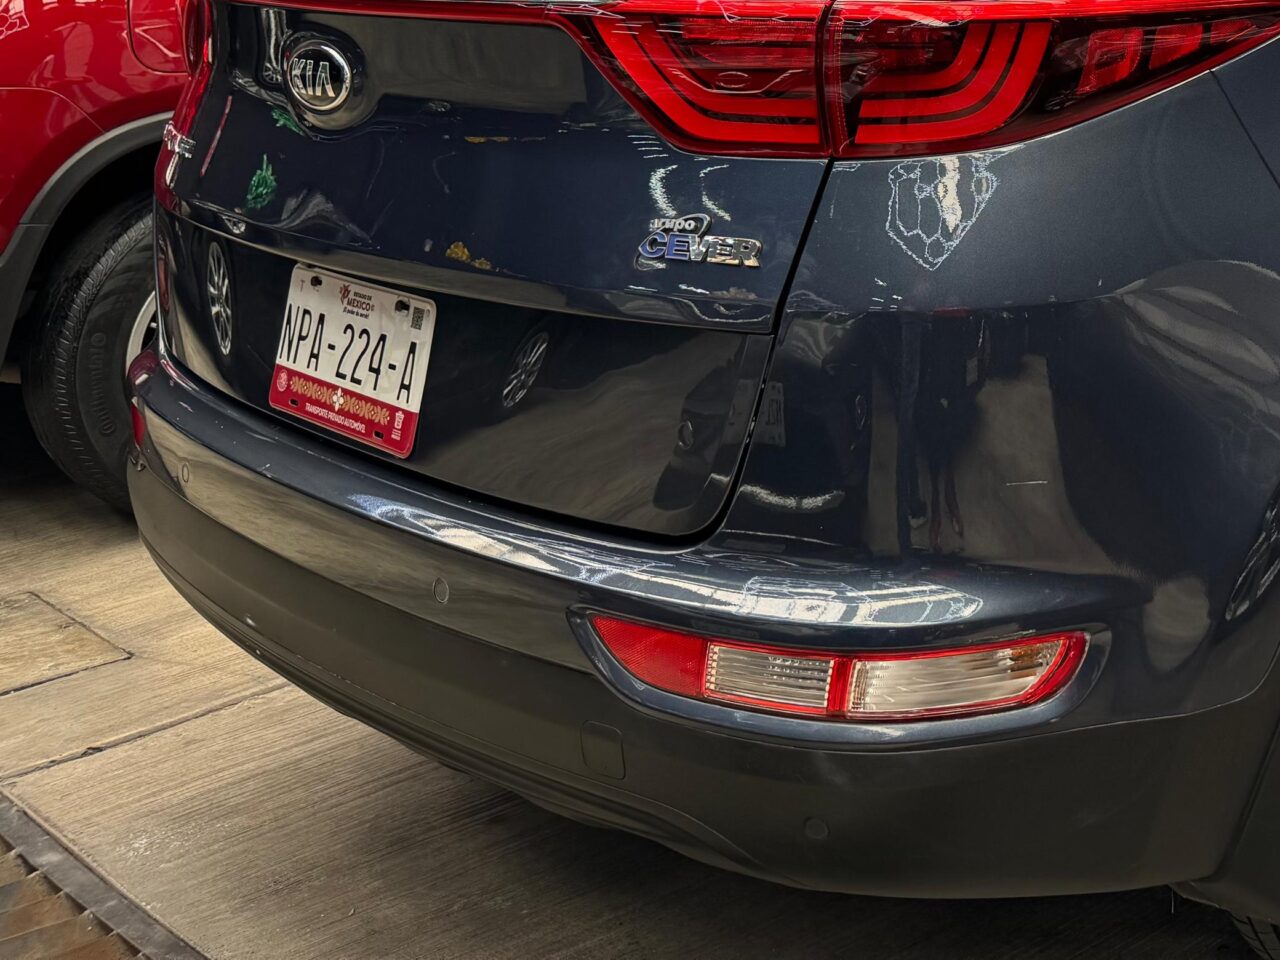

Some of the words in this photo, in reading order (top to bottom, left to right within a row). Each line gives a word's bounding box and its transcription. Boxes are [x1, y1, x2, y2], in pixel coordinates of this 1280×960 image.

[292, 58, 336, 97] KIA
[638, 231, 763, 268] CEVER
[279, 303, 418, 404] NPA-224-A
